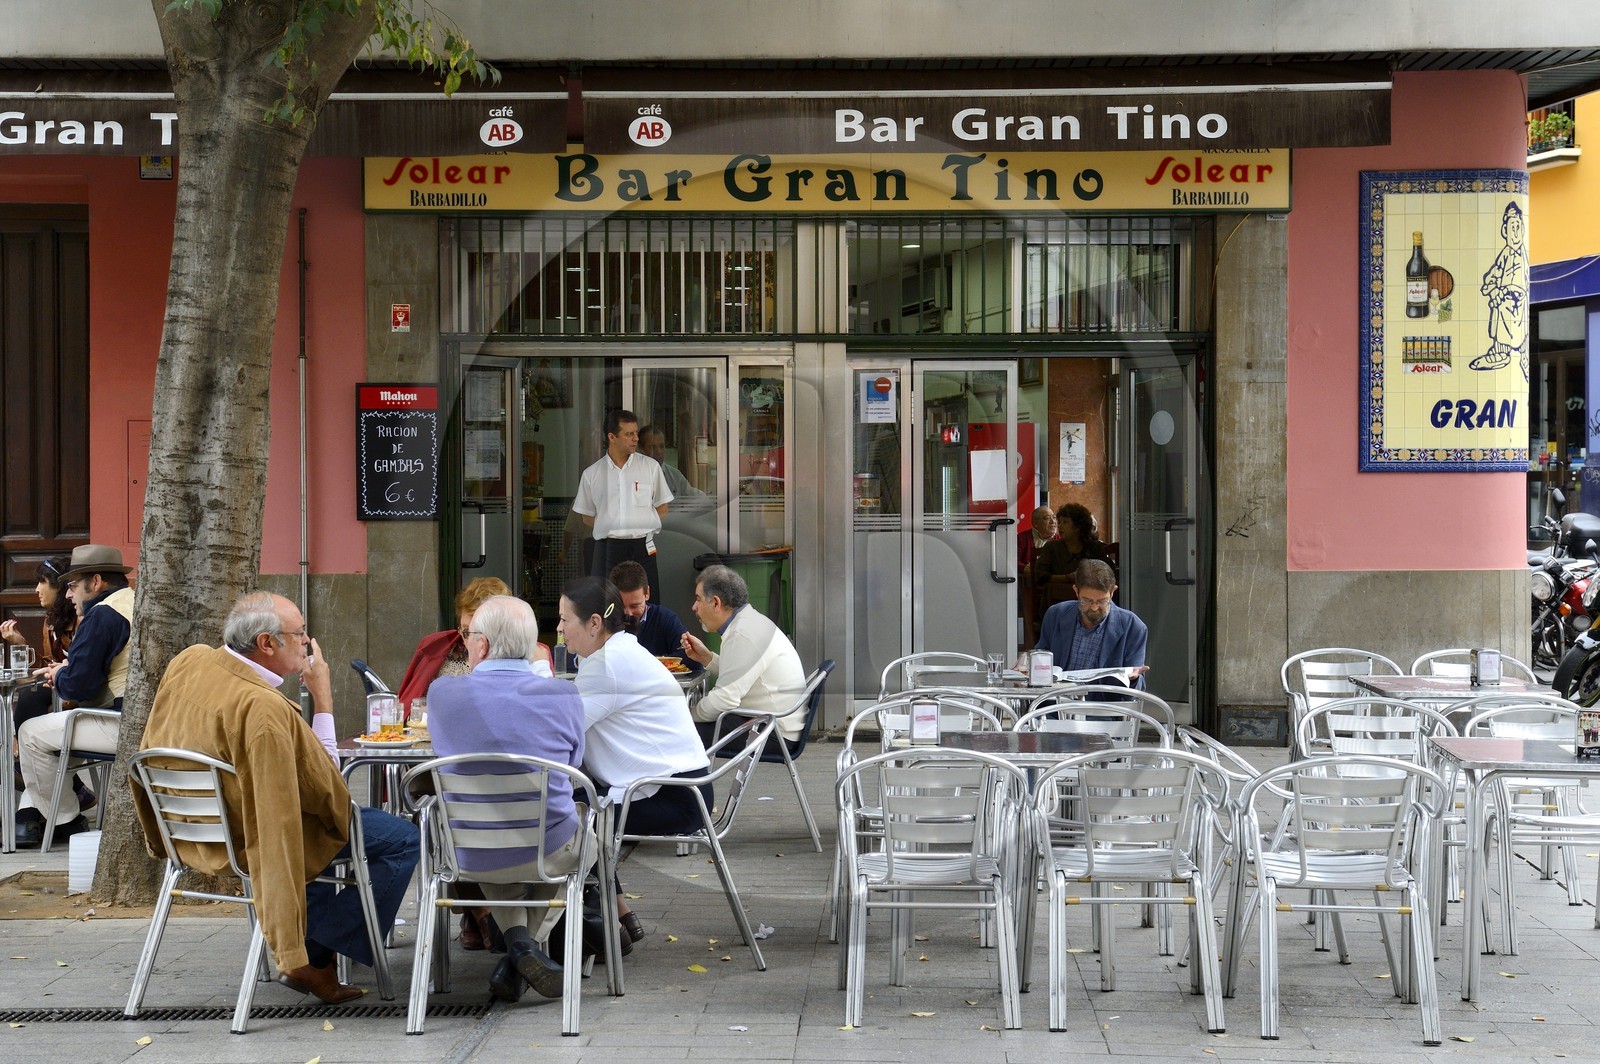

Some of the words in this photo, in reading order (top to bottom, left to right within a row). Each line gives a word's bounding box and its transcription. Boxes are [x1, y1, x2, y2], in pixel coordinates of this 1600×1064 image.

[489, 106, 514, 117] café
[637, 104, 662, 115] café
[0, 111, 124, 146] Gran
[150, 112, 179, 146] T
[487, 123, 516, 141] AB
[636, 122, 664, 140] AB
[835, 109, 924, 143] Bar
[951, 108, 1081, 141] Gran
[1106, 104, 1228, 140] Tino
[383, 157, 511, 186] Solear
[554, 153, 693, 202] Bar
[723, 153, 910, 202] Gran
[940, 152, 1104, 202] Tino
[1145, 156, 1273, 186] Solear
[1411, 364, 1443, 373] Solear
[379, 391, 418, 401] Mahou
[1430, 399, 1518, 430] GRAN
[375, 424, 418, 438] RACION
[391, 443, 404, 455] DE
[374, 458, 425, 475] GAMBAS
[384, 481, 401, 503] 6
